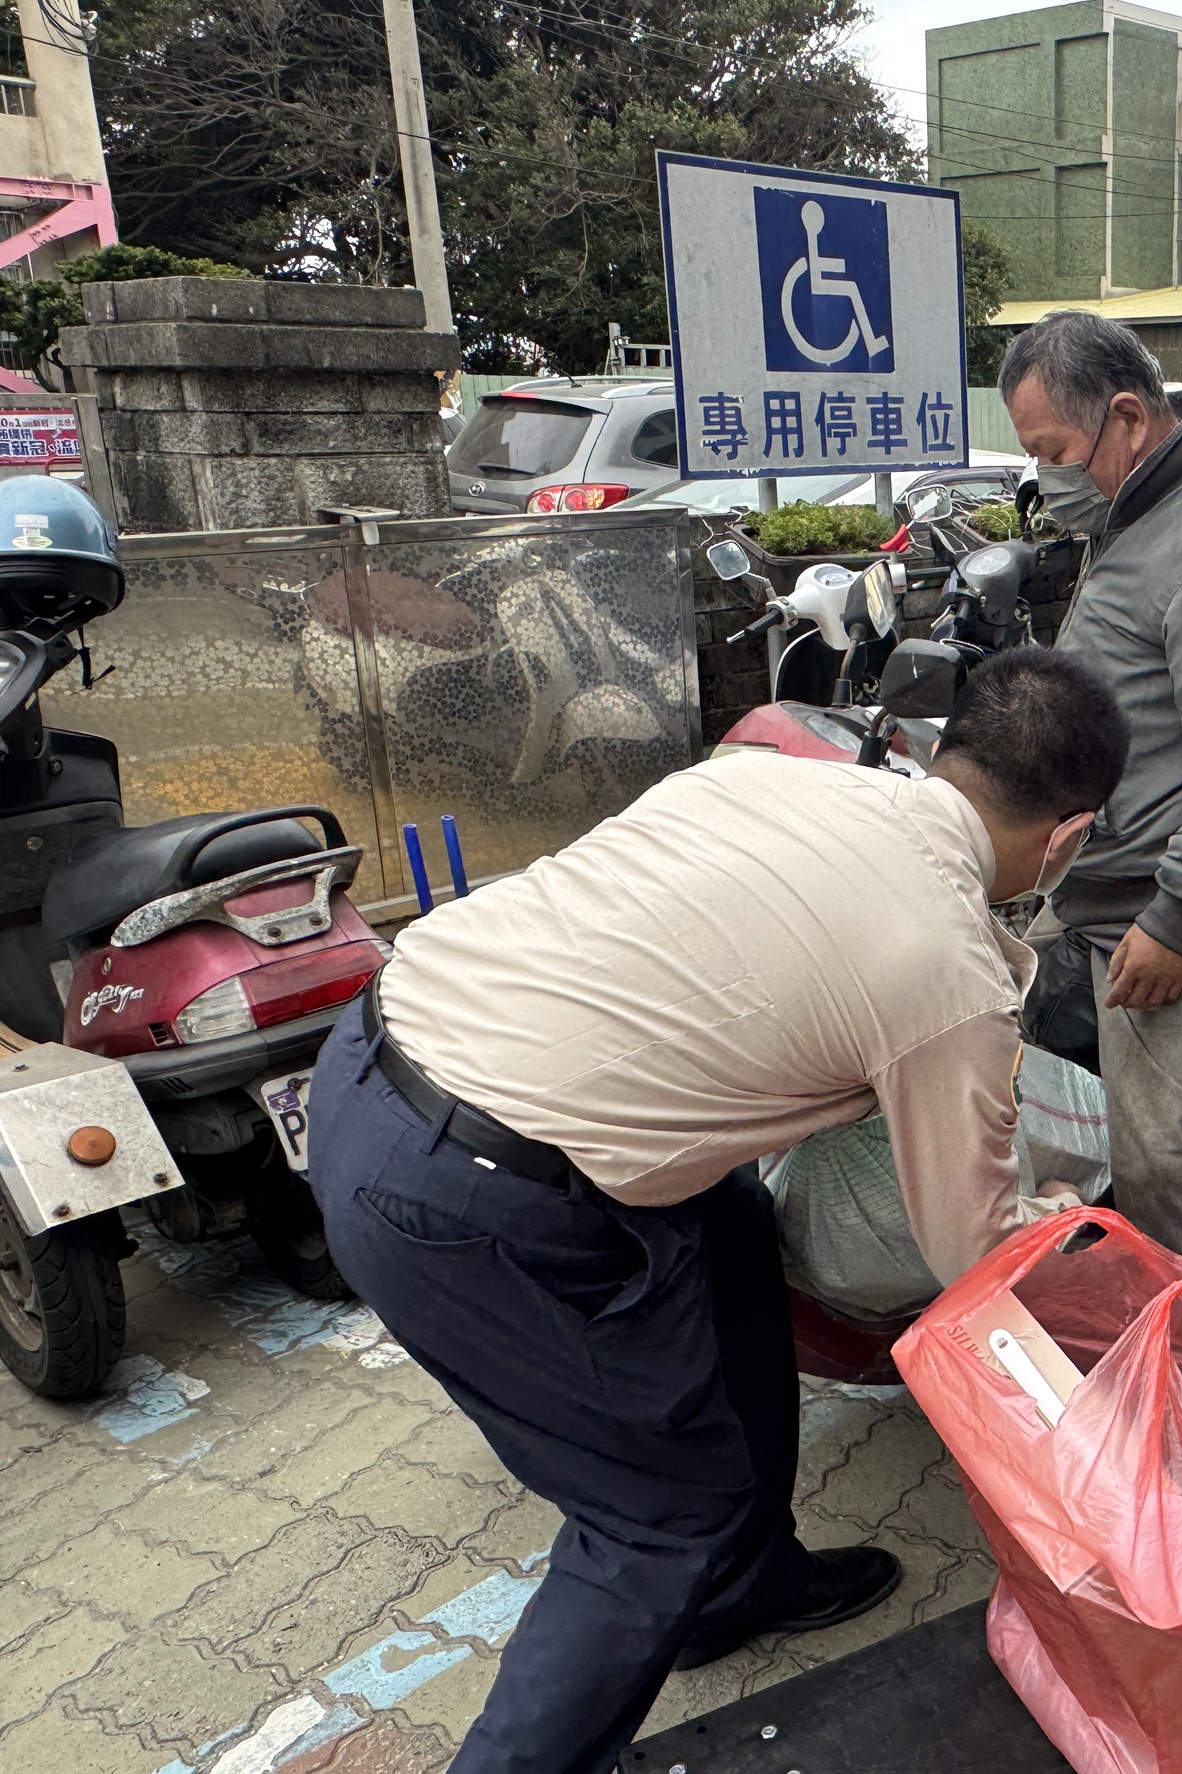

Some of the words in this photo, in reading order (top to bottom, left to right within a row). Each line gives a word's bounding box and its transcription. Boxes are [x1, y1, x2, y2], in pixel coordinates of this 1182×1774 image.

[698, 391, 956, 461] 專用停車位
[279, 1104, 309, 1157] P
